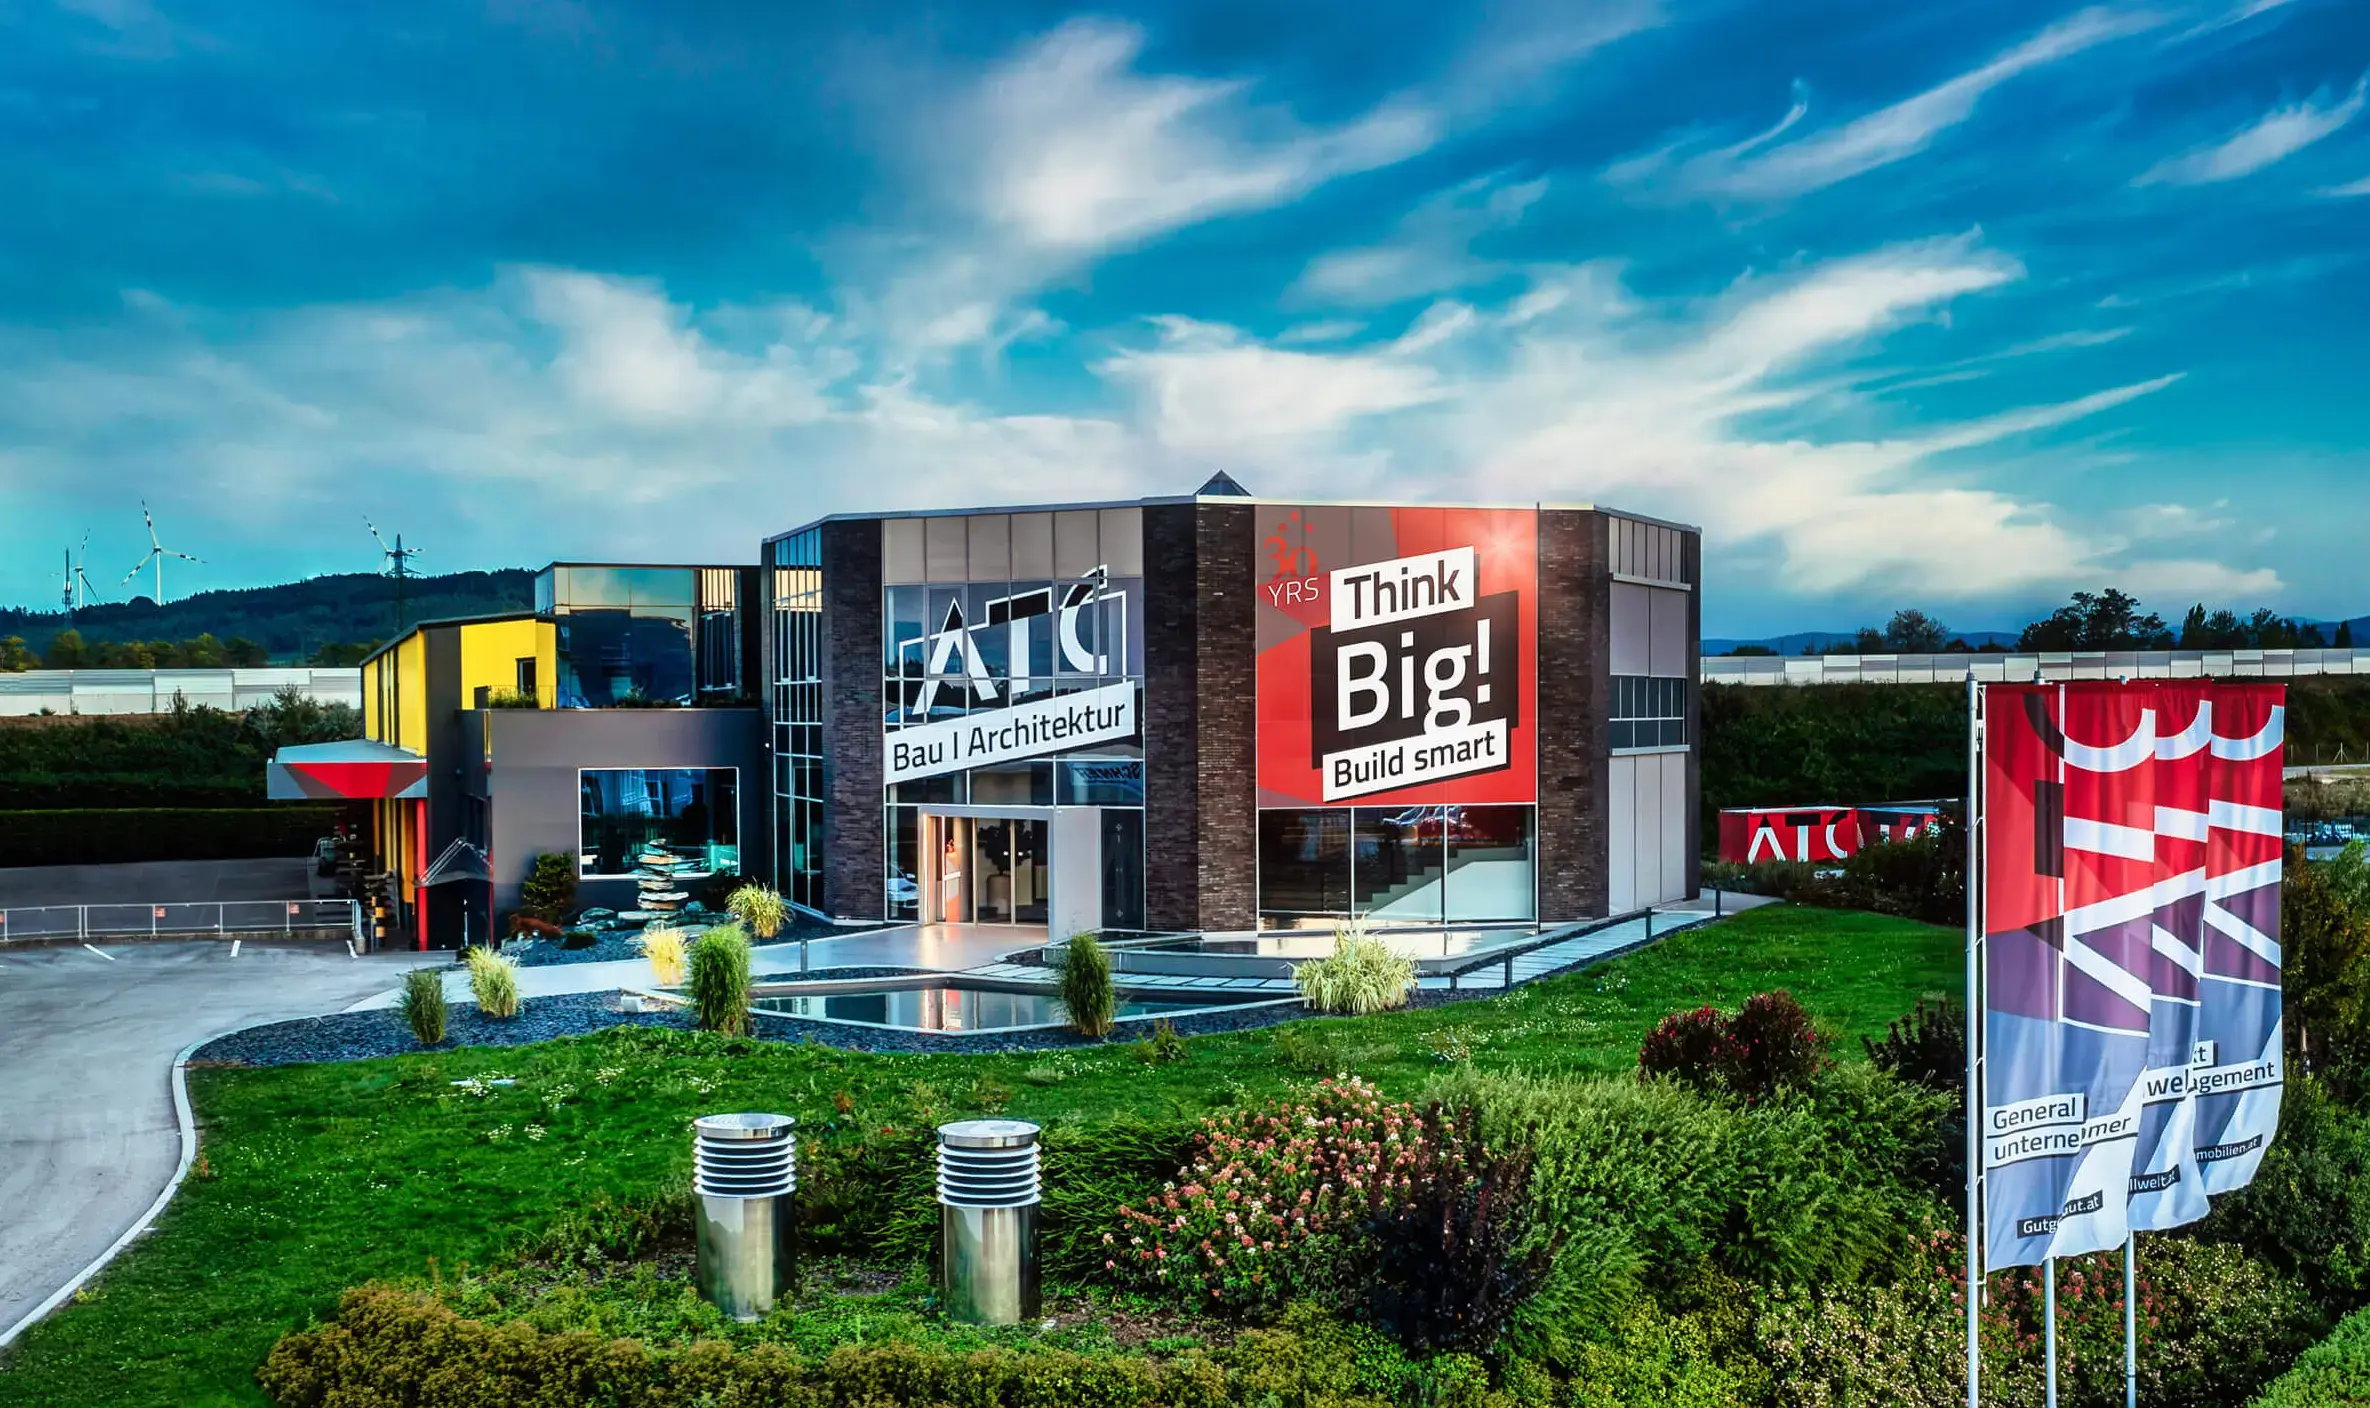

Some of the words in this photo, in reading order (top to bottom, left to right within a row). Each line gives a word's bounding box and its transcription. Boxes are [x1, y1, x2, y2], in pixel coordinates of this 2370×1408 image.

[1267, 577, 1319, 607] YRS
[1343, 560, 1460, 620] Think
[911, 564, 1107, 715] ATC
[1337, 618, 1491, 734] Big!
[893, 741, 943, 772] Bau
[968, 702, 1126, 757] Architektur
[1334, 746, 1403, 788] Build
[1414, 731, 1495, 772] smart
[1747, 811, 1849, 864] ATC
[1993, 1096, 2076, 1130] General
